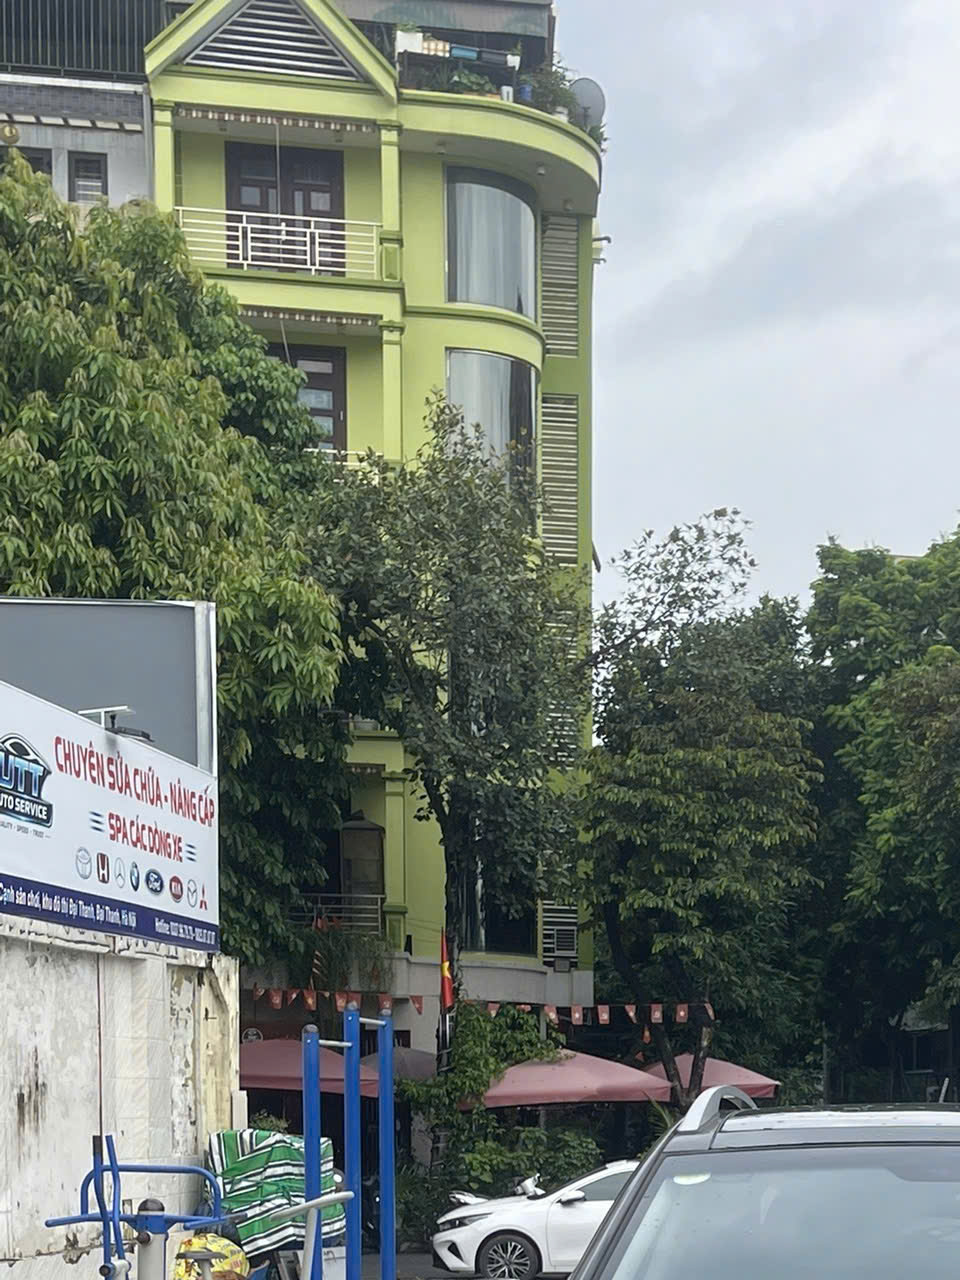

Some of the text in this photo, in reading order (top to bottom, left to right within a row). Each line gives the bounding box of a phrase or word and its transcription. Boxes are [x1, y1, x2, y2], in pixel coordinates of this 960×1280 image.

[54, 736, 105, 788] CHUYÊN
[107, 750, 132, 797] SỬA
[133, 766, 163, 809] CHỮA
[169, 777, 197, 822] NÂNG
[15, 797, 48, 820] SERVICE
[108, 812, 183, 863] SPA CÁC DÒNG XE
